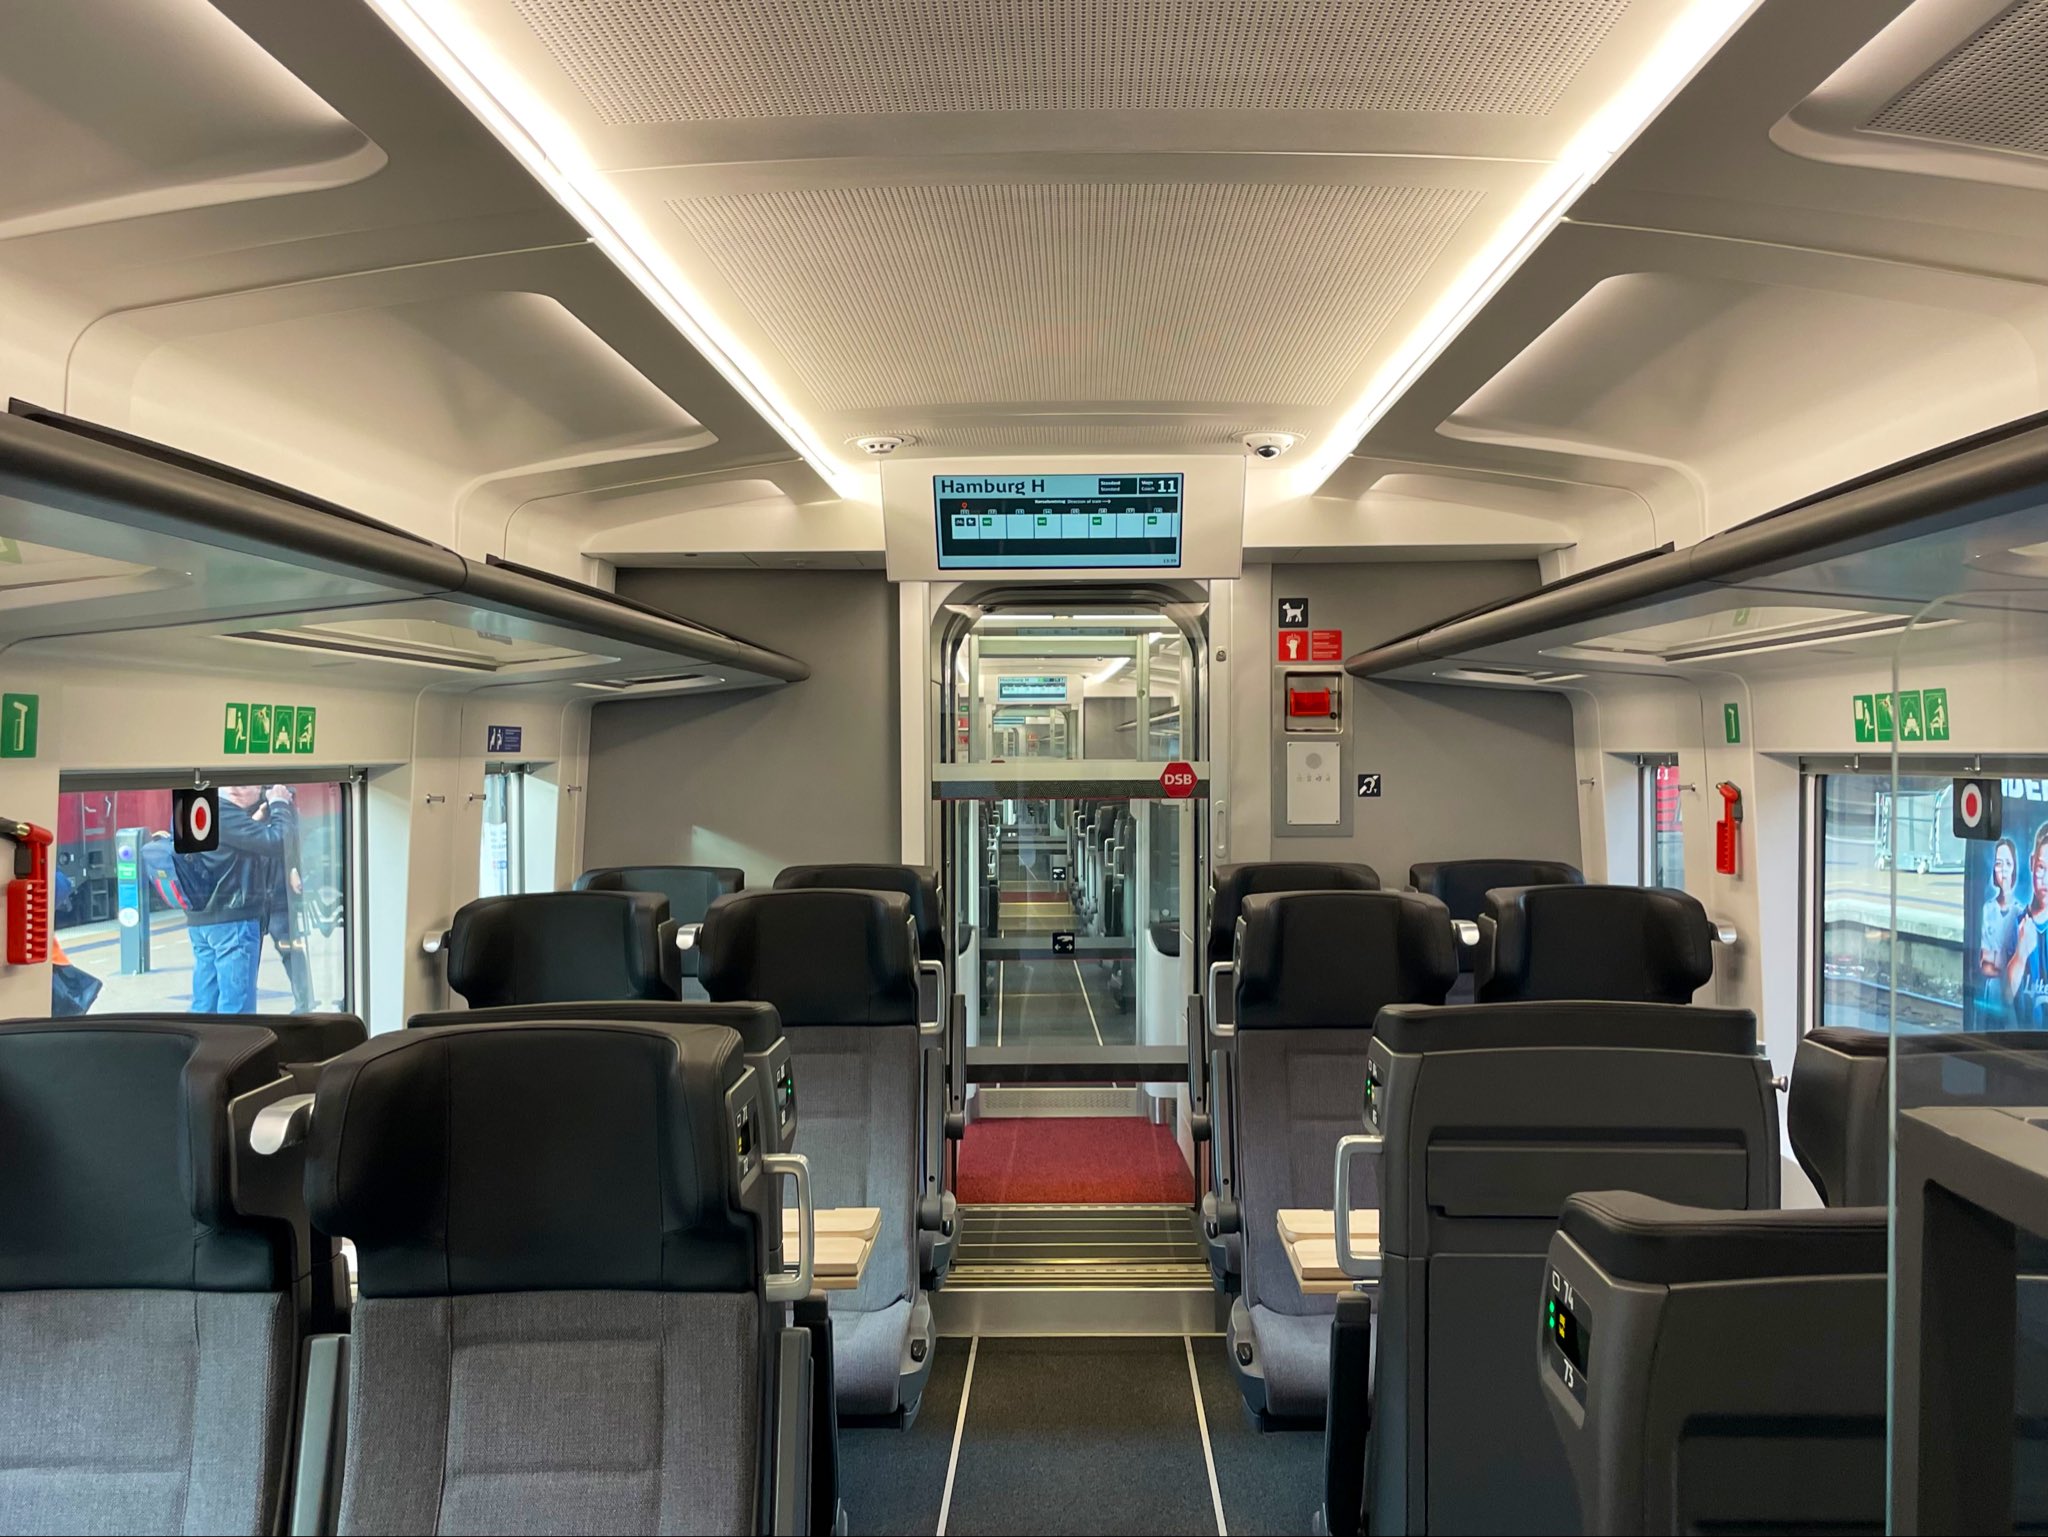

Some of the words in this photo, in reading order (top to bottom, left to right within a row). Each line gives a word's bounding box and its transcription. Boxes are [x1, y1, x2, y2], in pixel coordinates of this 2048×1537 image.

[941, 480, 1026, 496] Hamburg
[1032, 479, 1045, 493] H
[1157, 480, 1177, 493] 11
[1164, 773, 1193, 785] DSB
[1563, 1279, 1574, 1311] 74
[1563, 1358, 1574, 1388] 73
